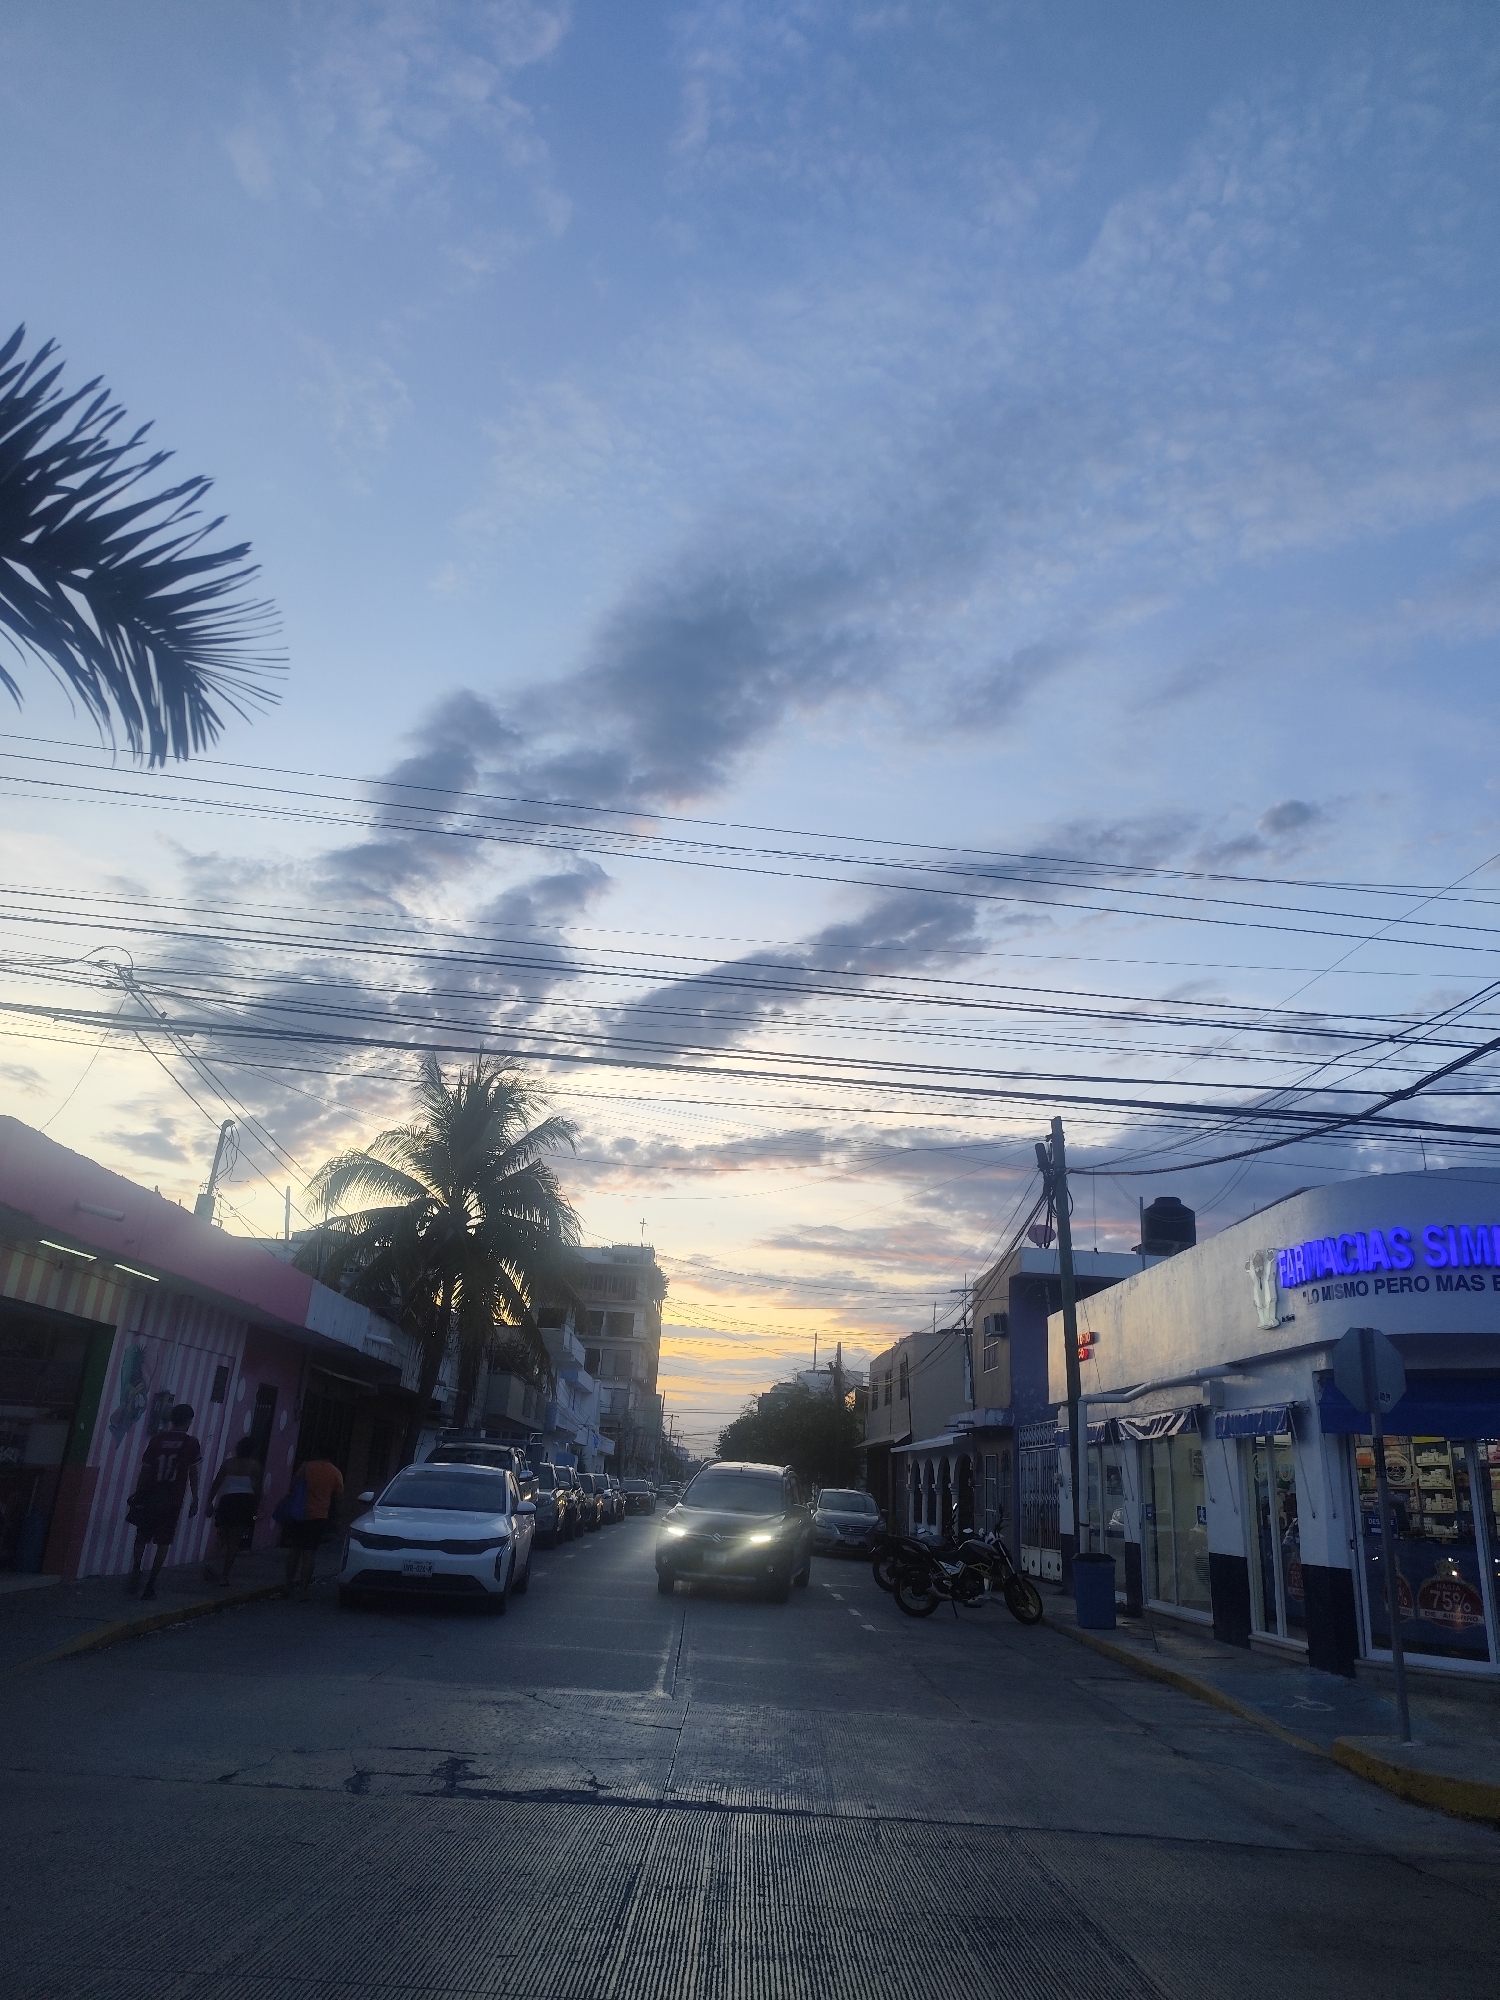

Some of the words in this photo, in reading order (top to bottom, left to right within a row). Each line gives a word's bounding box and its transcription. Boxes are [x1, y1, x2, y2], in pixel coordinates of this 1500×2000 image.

[1278, 1226, 1414, 1288] FARMACIAS
[1321, 1280, 1369, 1301] MISMO
[1374, 1275, 1430, 1295] PERO
[1436, 1275, 1485, 1292] MAS
[1436, 1583, 1460, 1591] HASTA
[1429, 1589, 1472, 1613] 75%
[1425, 1610, 1436, 1618] DE
